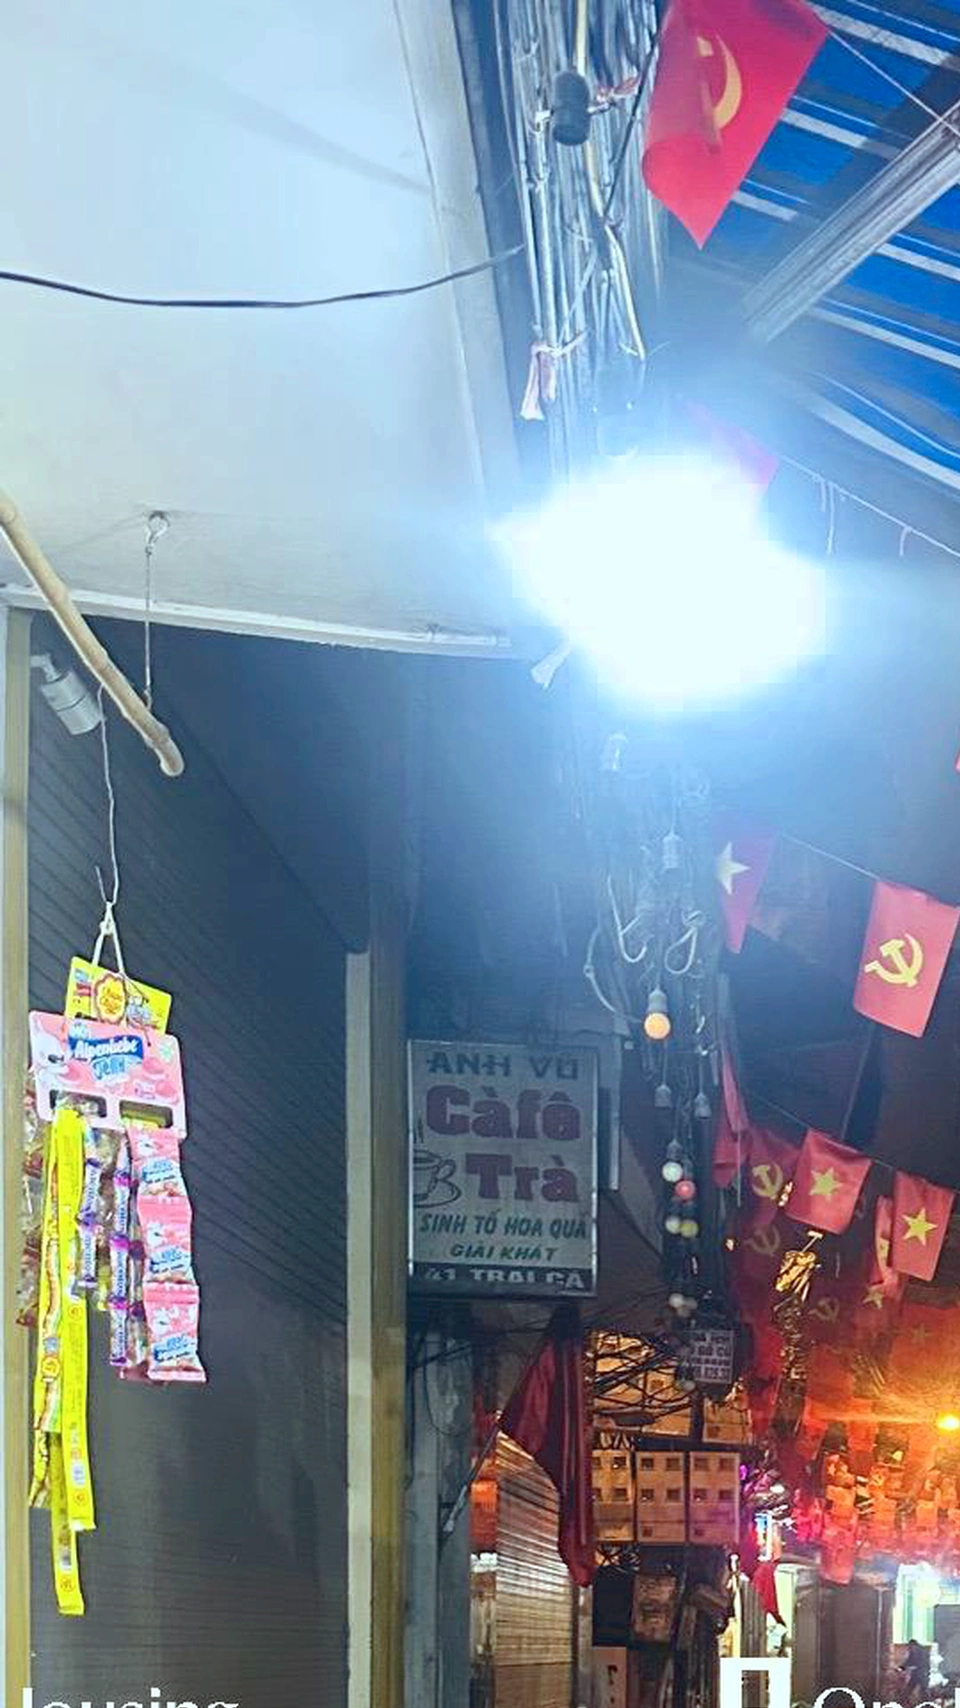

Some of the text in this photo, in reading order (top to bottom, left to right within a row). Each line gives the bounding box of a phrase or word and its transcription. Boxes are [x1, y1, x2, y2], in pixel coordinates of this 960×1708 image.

[426, 1051, 511, 1077] ANH
[465, 1153, 580, 1202] Trà
[419, 1213, 467, 1235] SINH
[503, 1215, 542, 1237] HOA
